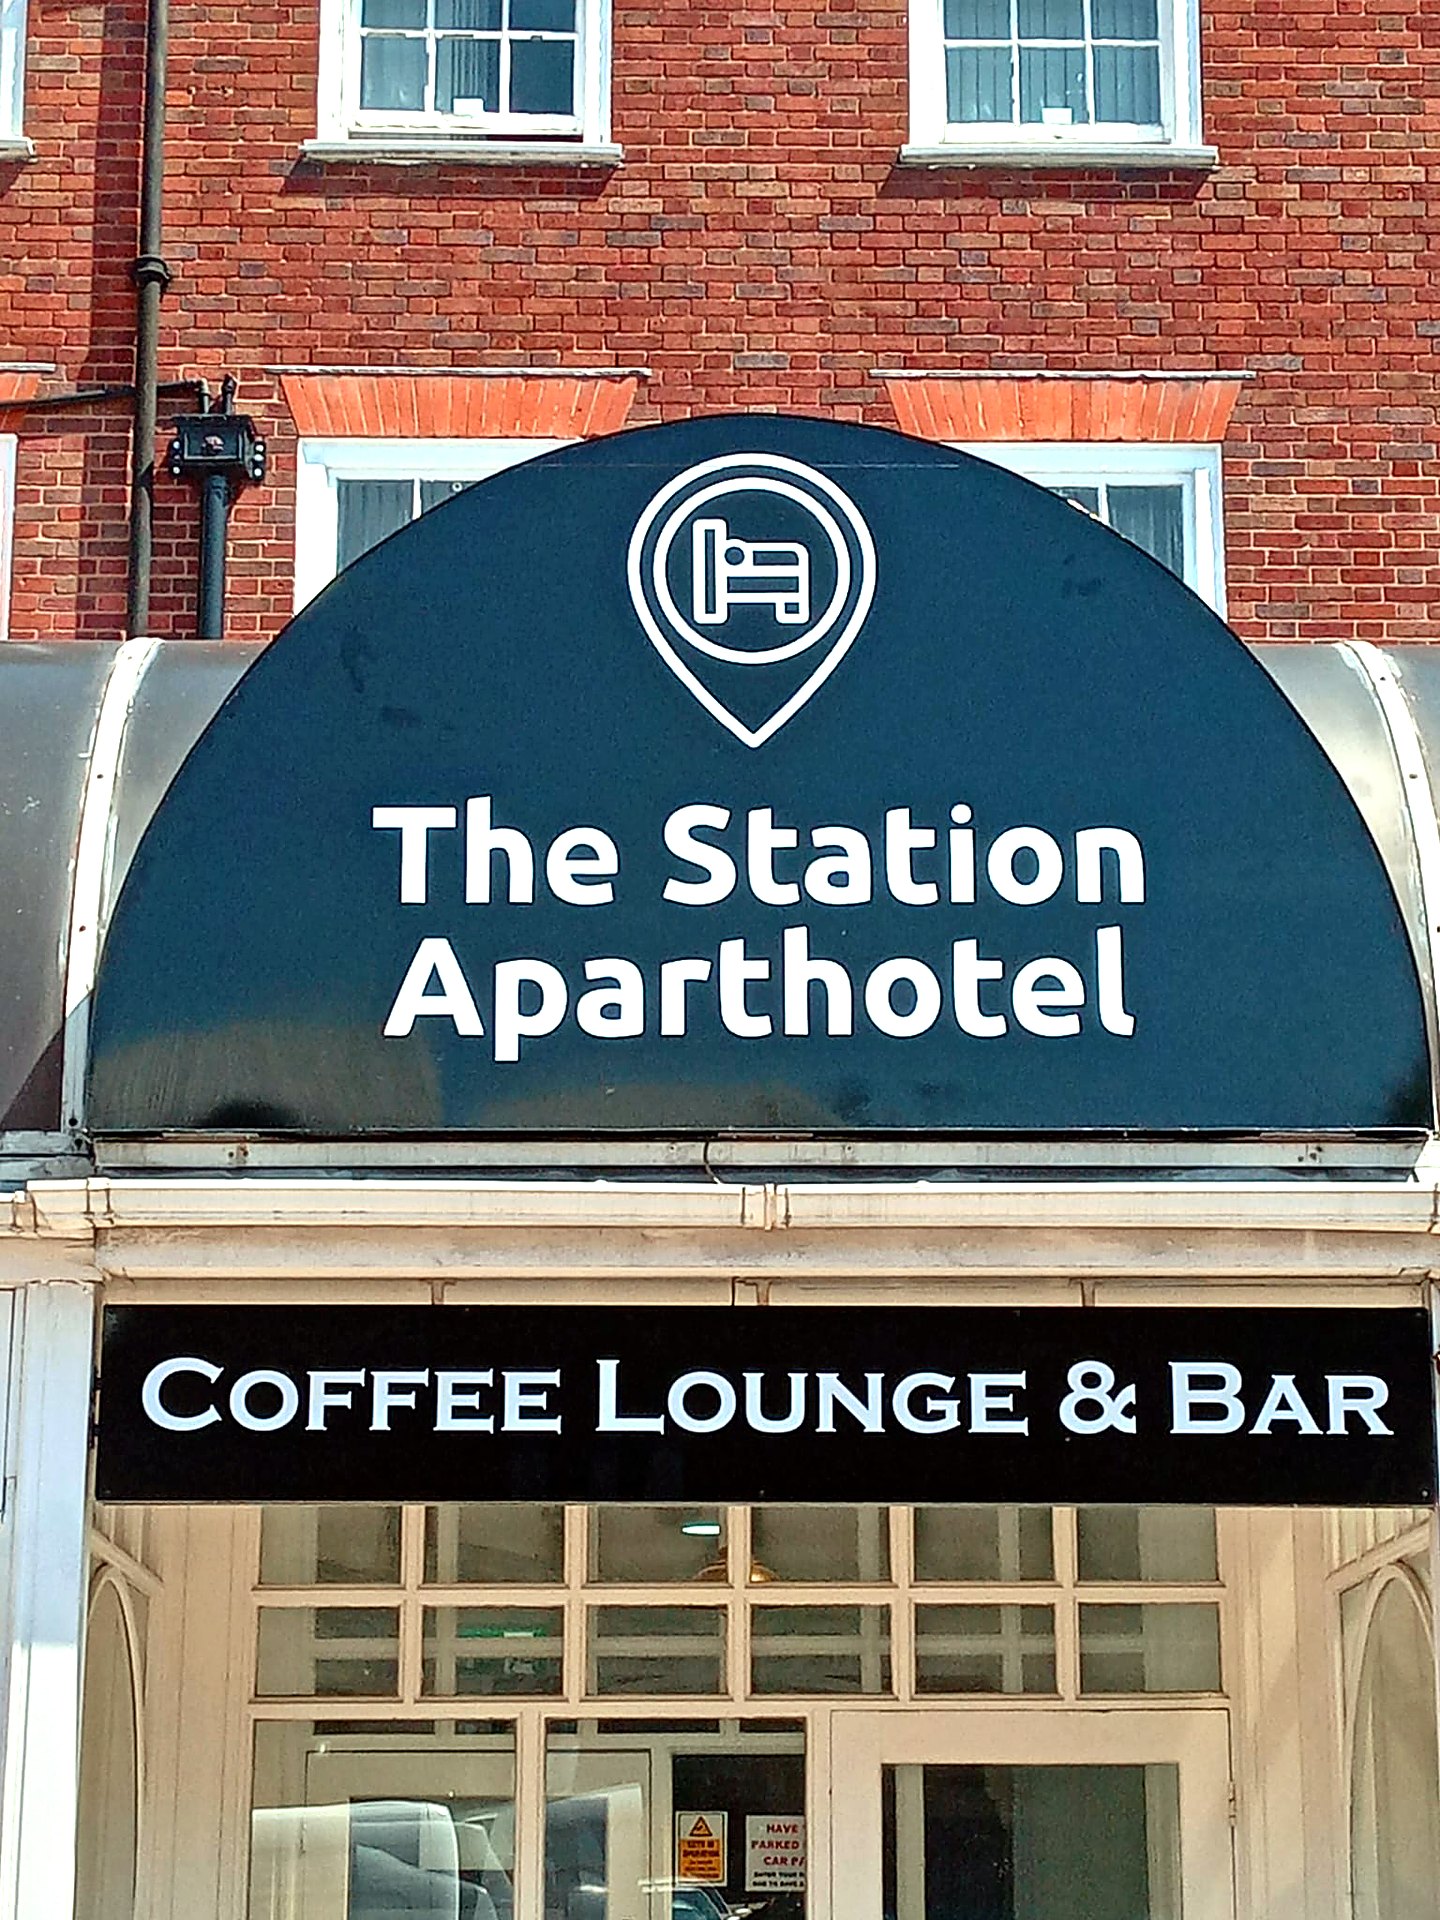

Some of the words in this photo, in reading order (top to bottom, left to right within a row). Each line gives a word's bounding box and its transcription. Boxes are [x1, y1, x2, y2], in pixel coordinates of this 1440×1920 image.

[372, 795, 616, 906] The
[662, 803, 1145, 906] Station
[383, 925, 1135, 1062] Aparthotel
[141, 1357, 562, 1435] COFFEE
[595, 1359, 1029, 1437] LOUNGE
[1059, 1360, 1137, 1436] &
[1167, 1361, 1396, 1437] BAR
[751, 1841, 800, 1850] PARKED
[766, 1824, 799, 1834] HAVE
[763, 1856, 788, 1866] CAR
